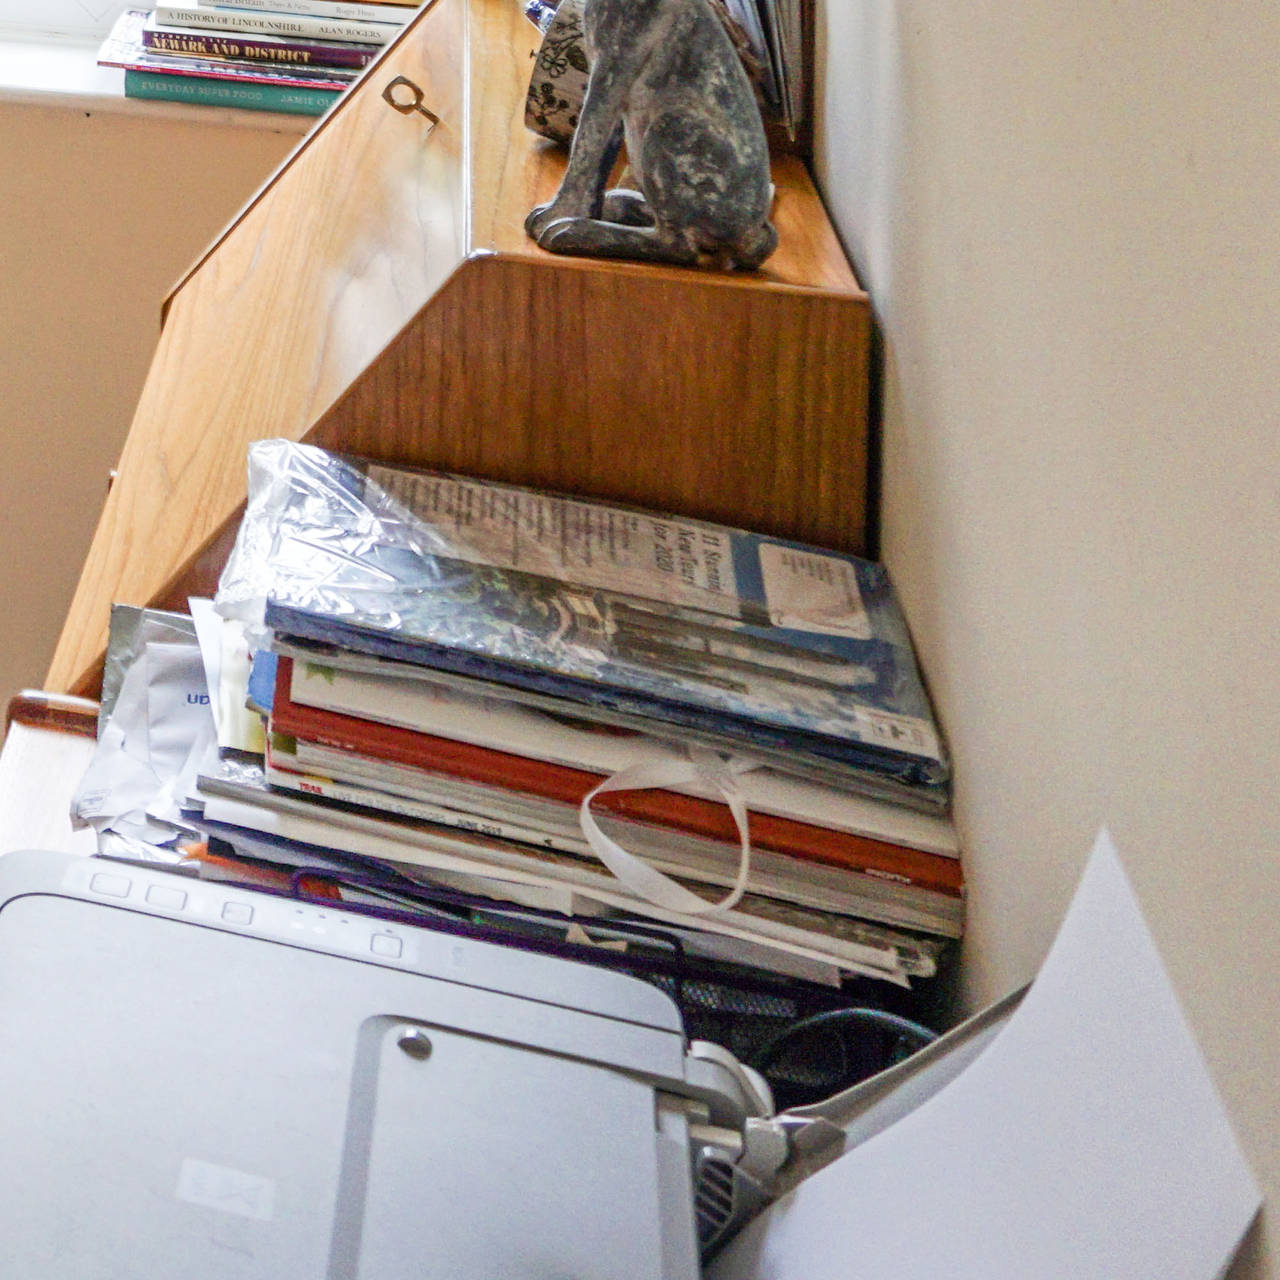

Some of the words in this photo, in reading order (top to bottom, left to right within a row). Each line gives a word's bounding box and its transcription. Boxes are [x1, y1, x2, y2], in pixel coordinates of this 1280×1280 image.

[167, 12, 175, 20] A
[176, 12, 217, 24] HISTORY
[218, 16, 230, 25] OF
[233, 17, 304, 33] LINCOLNSHIRE
[318, 25, 344, 36] ALAN
[345, 27, 381, 39] ROGERS
[153, 36, 208, 53] NEWARK
[211, 41, 239, 56] AND
[244, 46, 311, 63] DISTRICT
[142, 79, 196, 96] EVERYDAY
[198, 84, 231, 97] SUPER
[232, 88, 263, 101] FOOD
[281, 93, 312, 105] JAMIE
